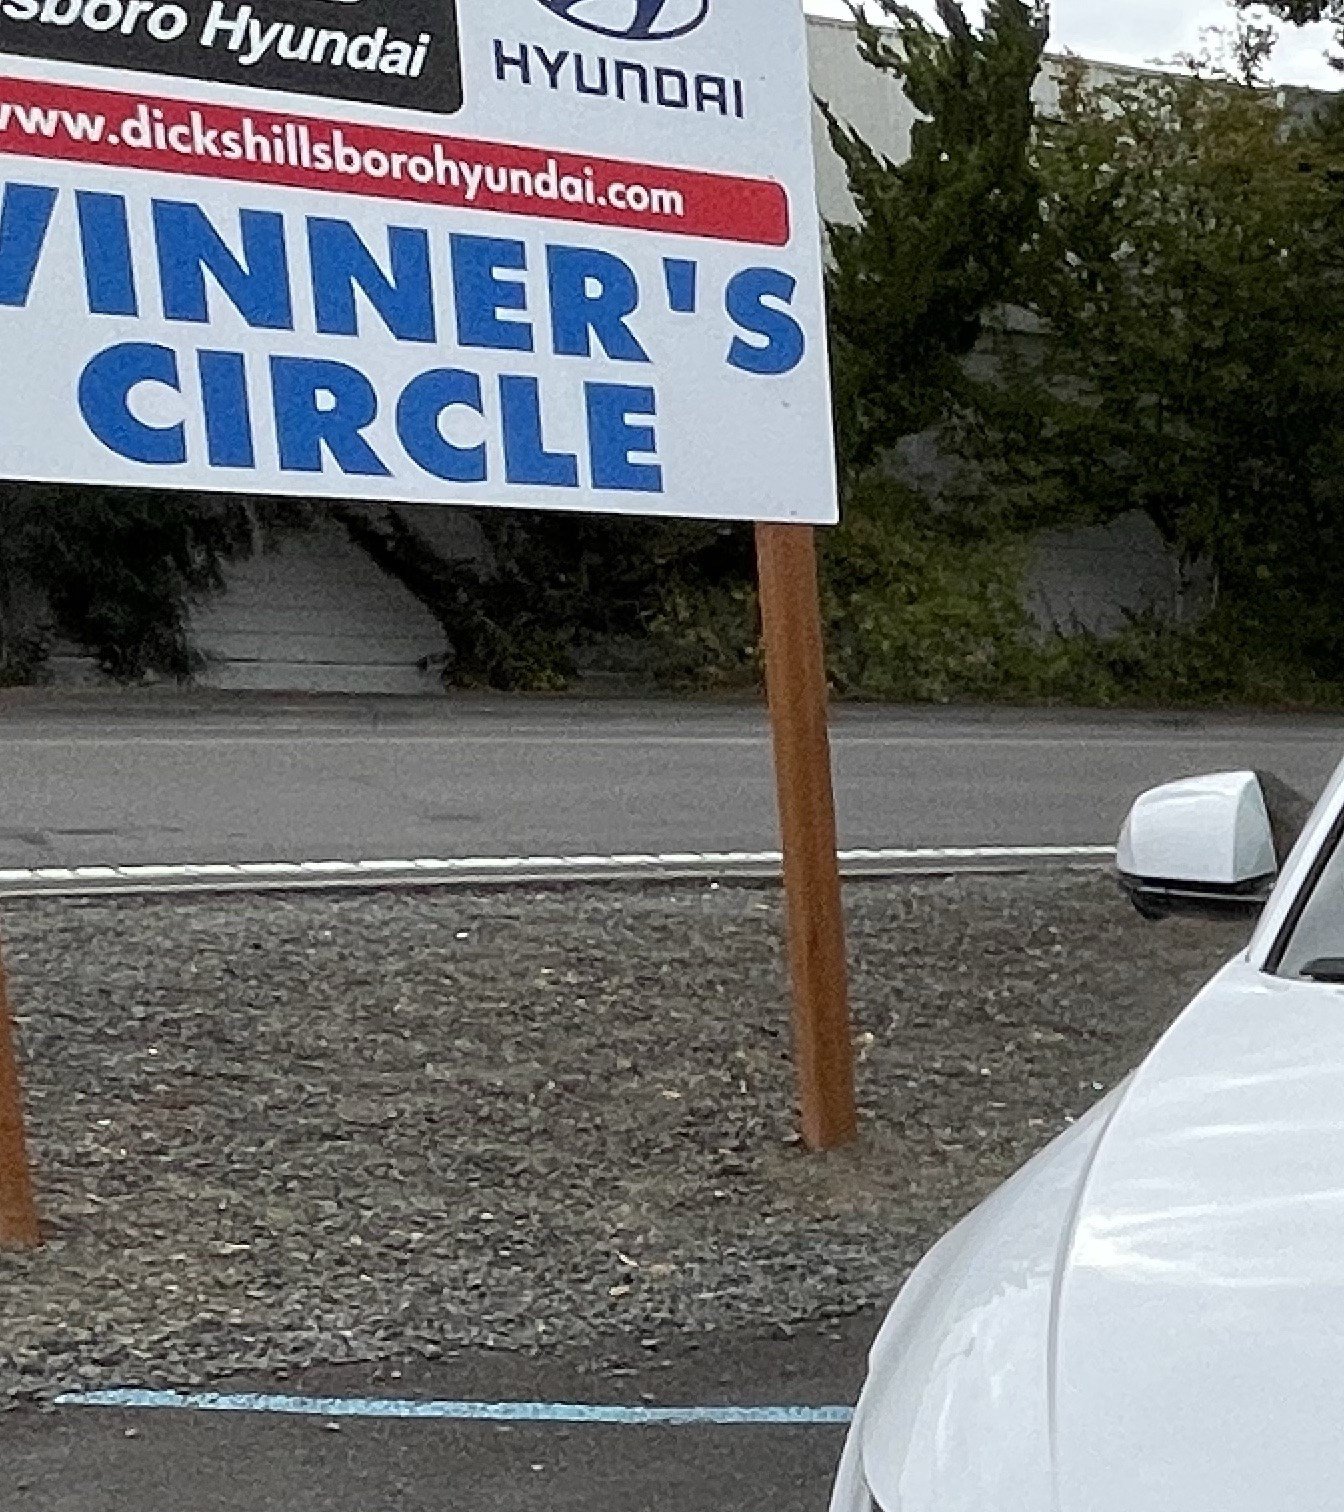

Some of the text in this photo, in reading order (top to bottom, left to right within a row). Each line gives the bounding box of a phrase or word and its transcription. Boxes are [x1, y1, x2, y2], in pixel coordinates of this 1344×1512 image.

[2, 0, 430, 79] sboro Hyundai
[493, 38, 744, 118] HYUNDAI
[0, 102, 684, 216] ww.dickshillsborohyundai.com
[77, 342, 664, 493] CIRCLE
